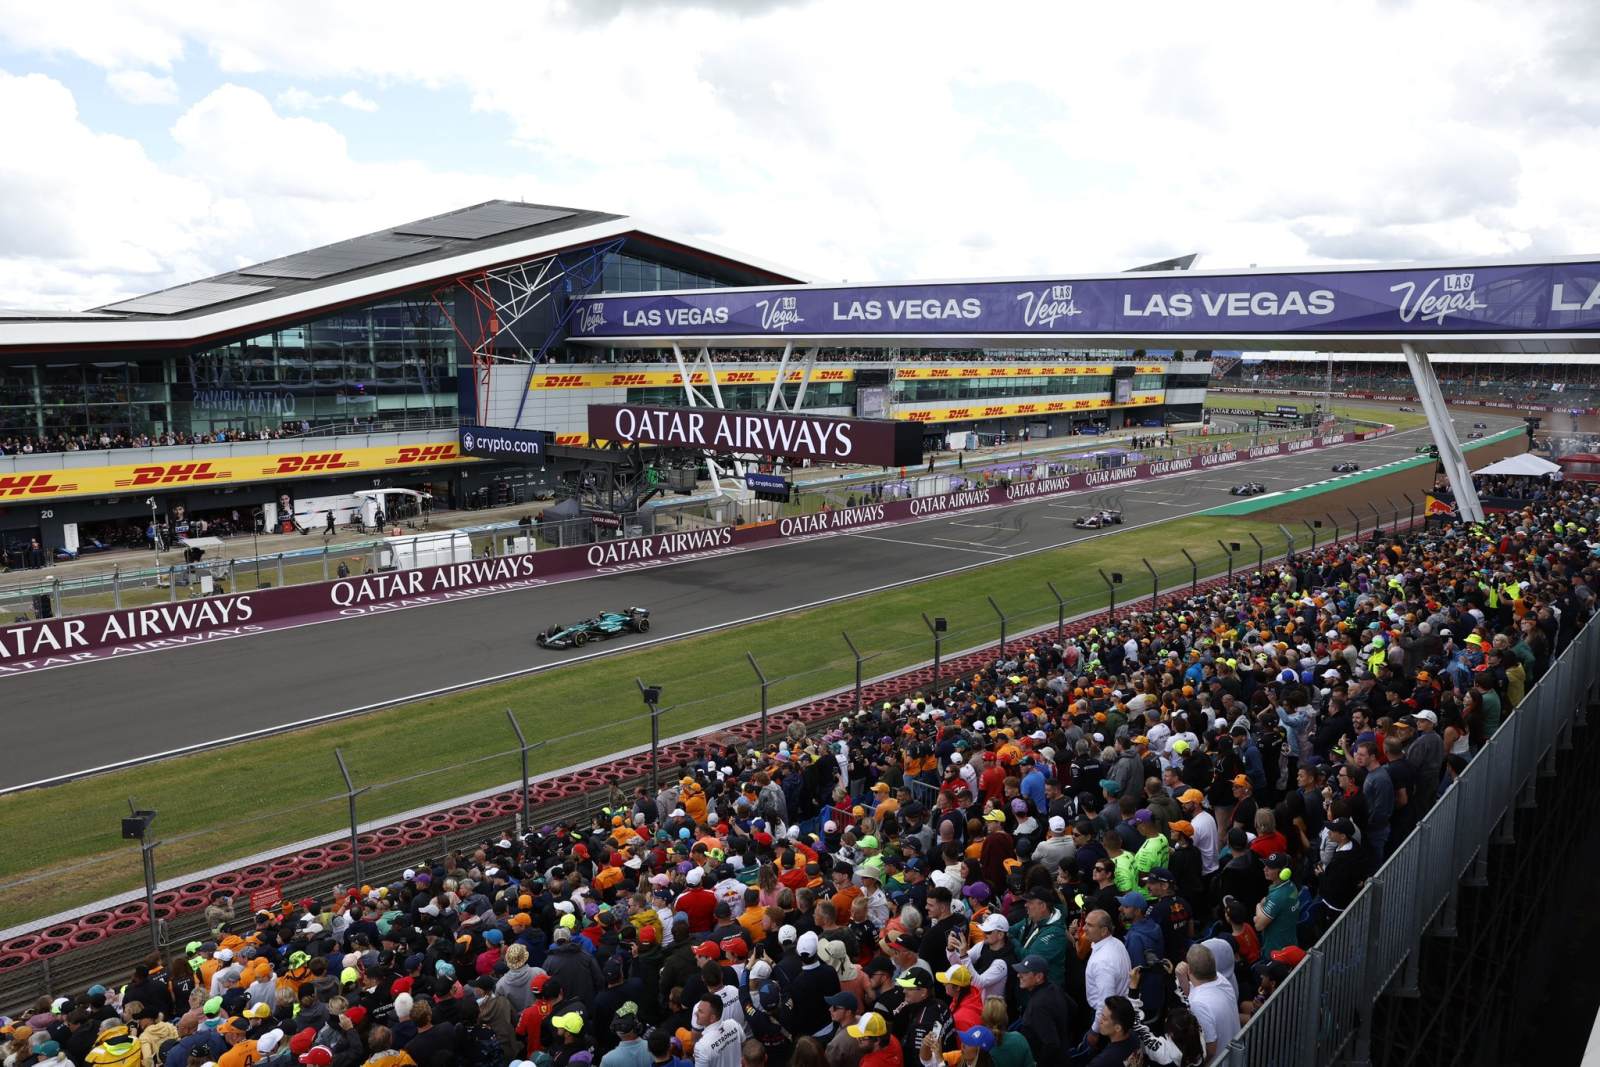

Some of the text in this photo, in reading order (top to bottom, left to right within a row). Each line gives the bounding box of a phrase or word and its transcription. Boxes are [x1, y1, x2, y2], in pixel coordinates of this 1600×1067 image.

[1053, 286, 1072, 300] LAS
[1446, 275, 1472, 290] LAS
[833, 298, 982, 321] LAS VEGAS
[1017, 288, 1083, 329] Vegas
[1123, 289, 1336, 317] LAS VEGAS
[1389, 278, 1488, 326] Vegas
[576, 304, 608, 334] Vegas
[622, 307, 729, 327] LAS VEGAS
[756, 297, 805, 332] Vegas
[544, 375, 584, 387] DHL
[611, 374, 648, 385] DHL
[727, 372, 755, 382] DHL
[820, 371, 844, 380] DHL
[615, 408, 852, 457] QATAR AIRWAYS
[397, 445, 458, 464] DHL
[476, 437, 539, 454] crypto.com
[276, 452, 348, 473] DHL
[1150, 458, 1192, 475] QATAR AIRWAYS
[1201, 450, 1238, 466] QATAR AIRWAYS
[132, 462, 217, 486] DHL
[755, 480, 784, 489] crypto.com
[1085, 466, 1137, 486] QATAR AIRWAYS
[1006, 477, 1070, 500] QATAR AIRWAYS
[910, 496, 946, 515] QATAR
[948, 488, 990, 508] AIRWAYS
[41, 510, 54, 519] 20
[780, 513, 828, 536] QATAR
[831, 504, 885, 528] AIRWAYS
[587, 527, 732, 567] QATAR AIRWAYS
[330, 554, 534, 607] QATAR AIRWAYS
[100, 595, 254, 642] AIRWAYS
[710, 1028, 738, 1050] PETRONAS
